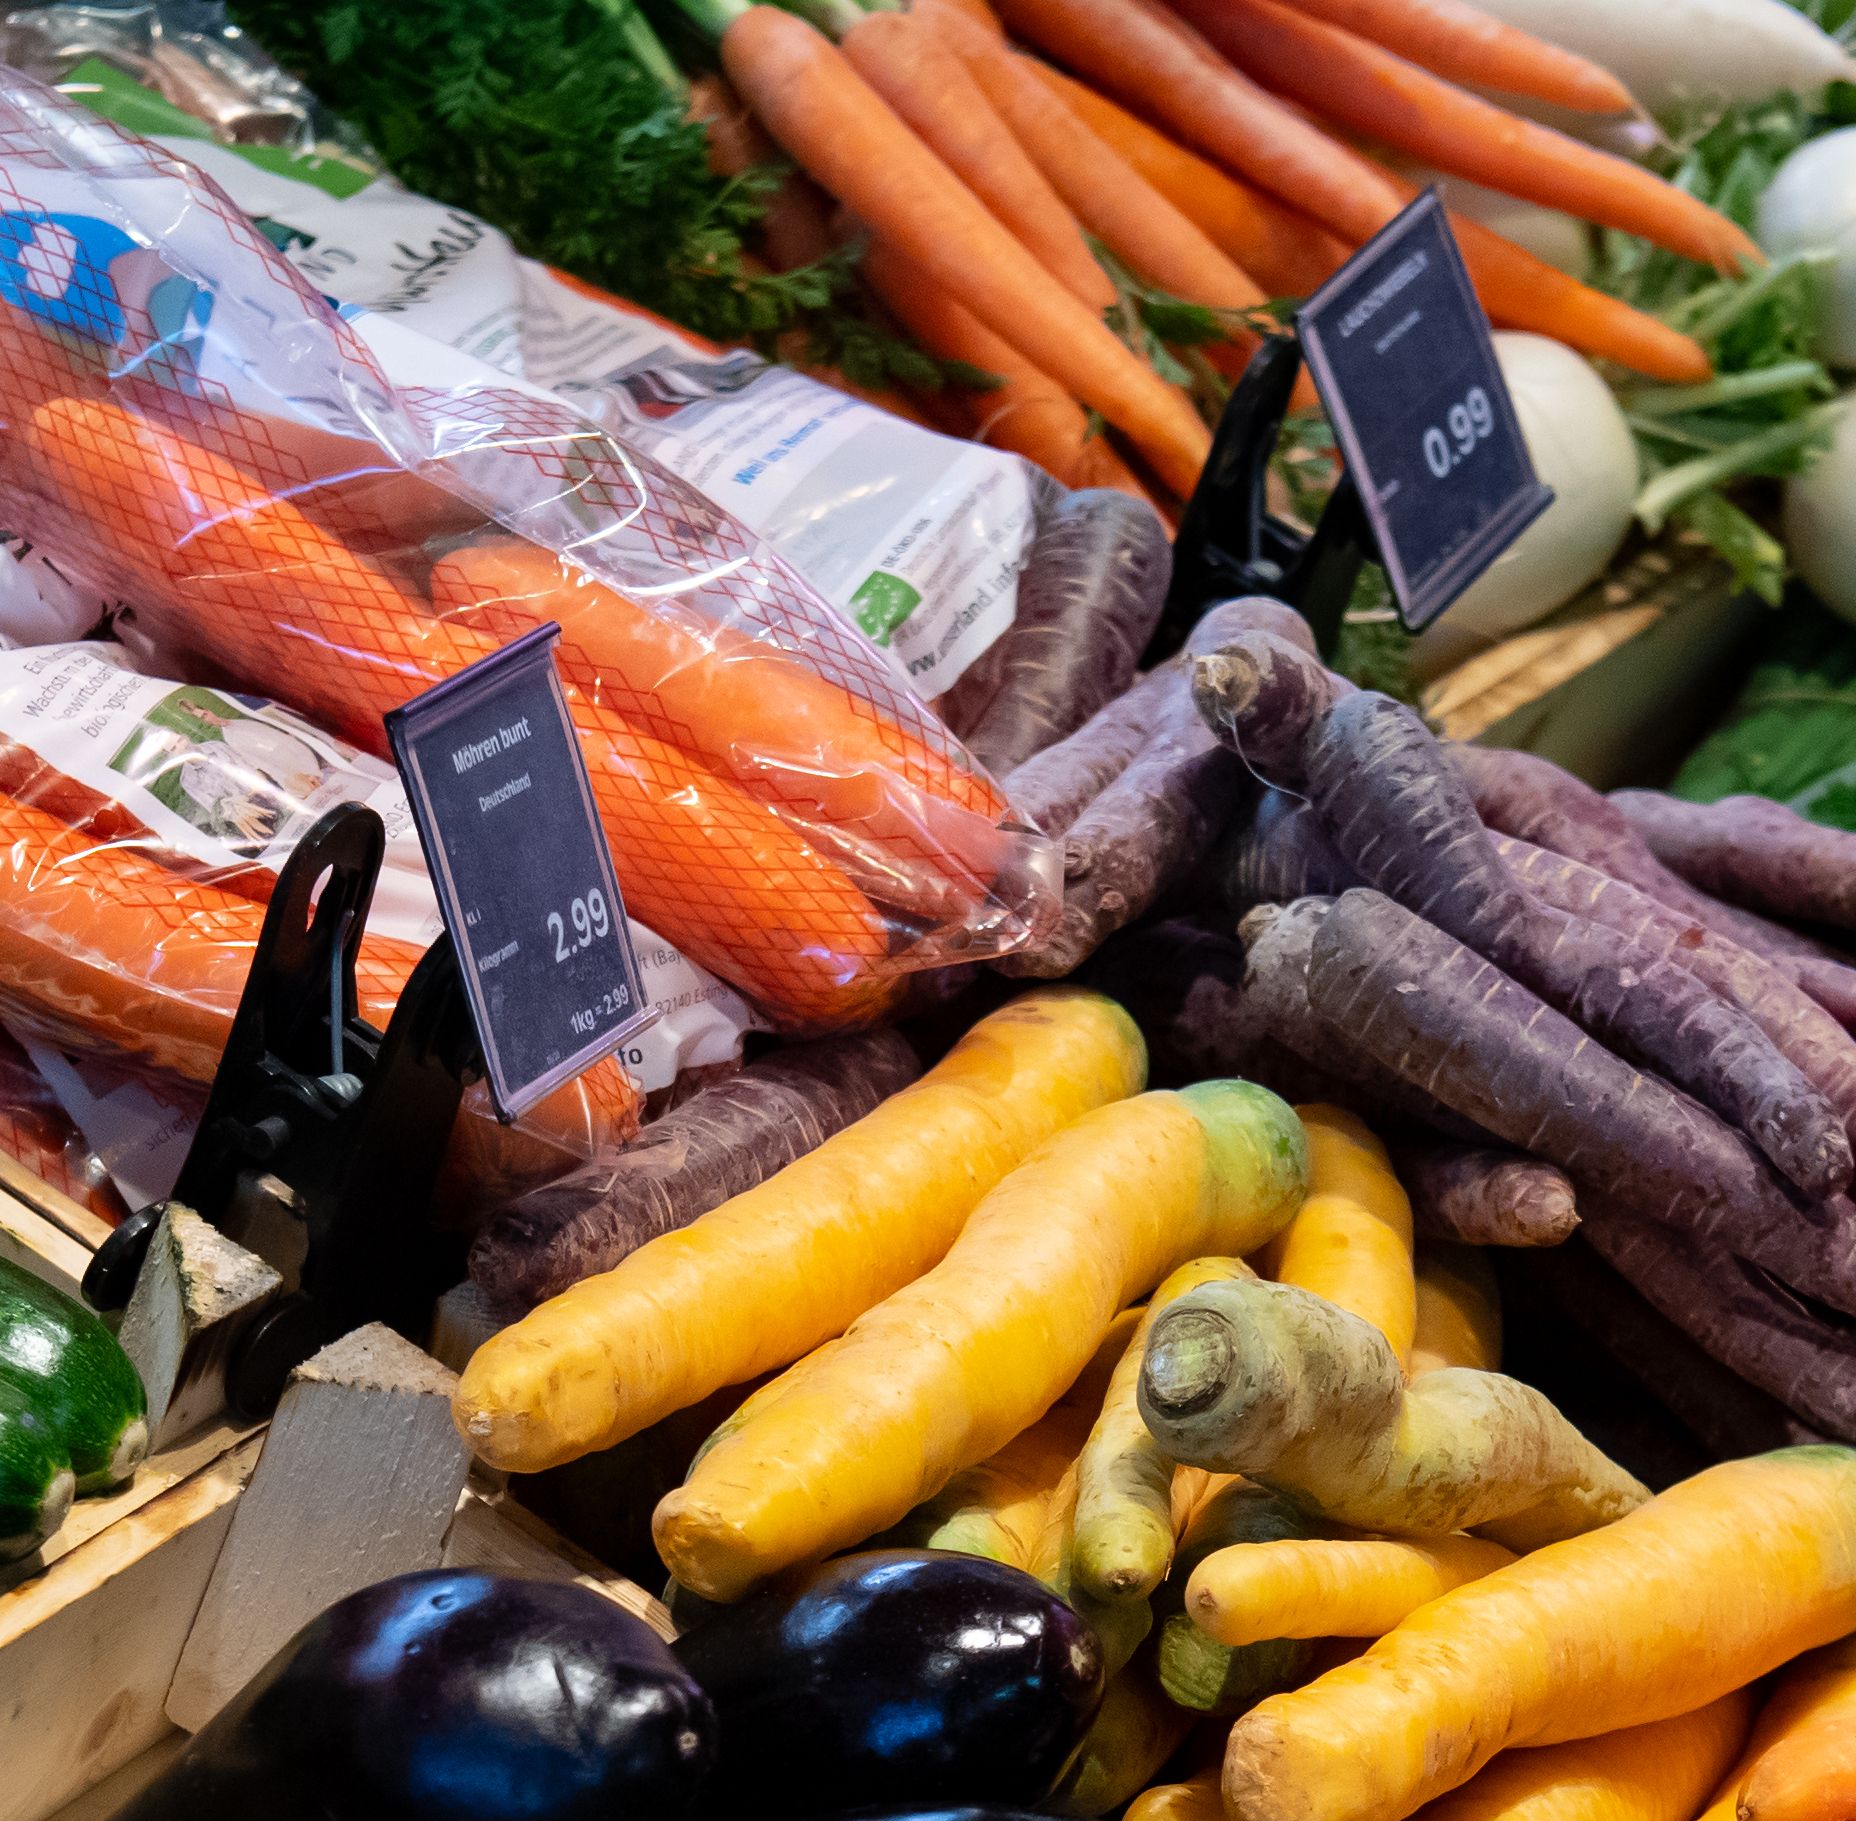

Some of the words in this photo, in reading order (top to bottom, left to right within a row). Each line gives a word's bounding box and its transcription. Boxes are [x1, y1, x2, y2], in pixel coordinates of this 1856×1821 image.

[1423, 388, 1495, 478] 0.99
[452, 735, 501, 775] Möhren
[499, 716, 532, 749] bunt
[479, 772, 532, 812] Deutschland
[547, 888, 609, 963] 2.99
[478, 940, 519, 973] Kilogramm
